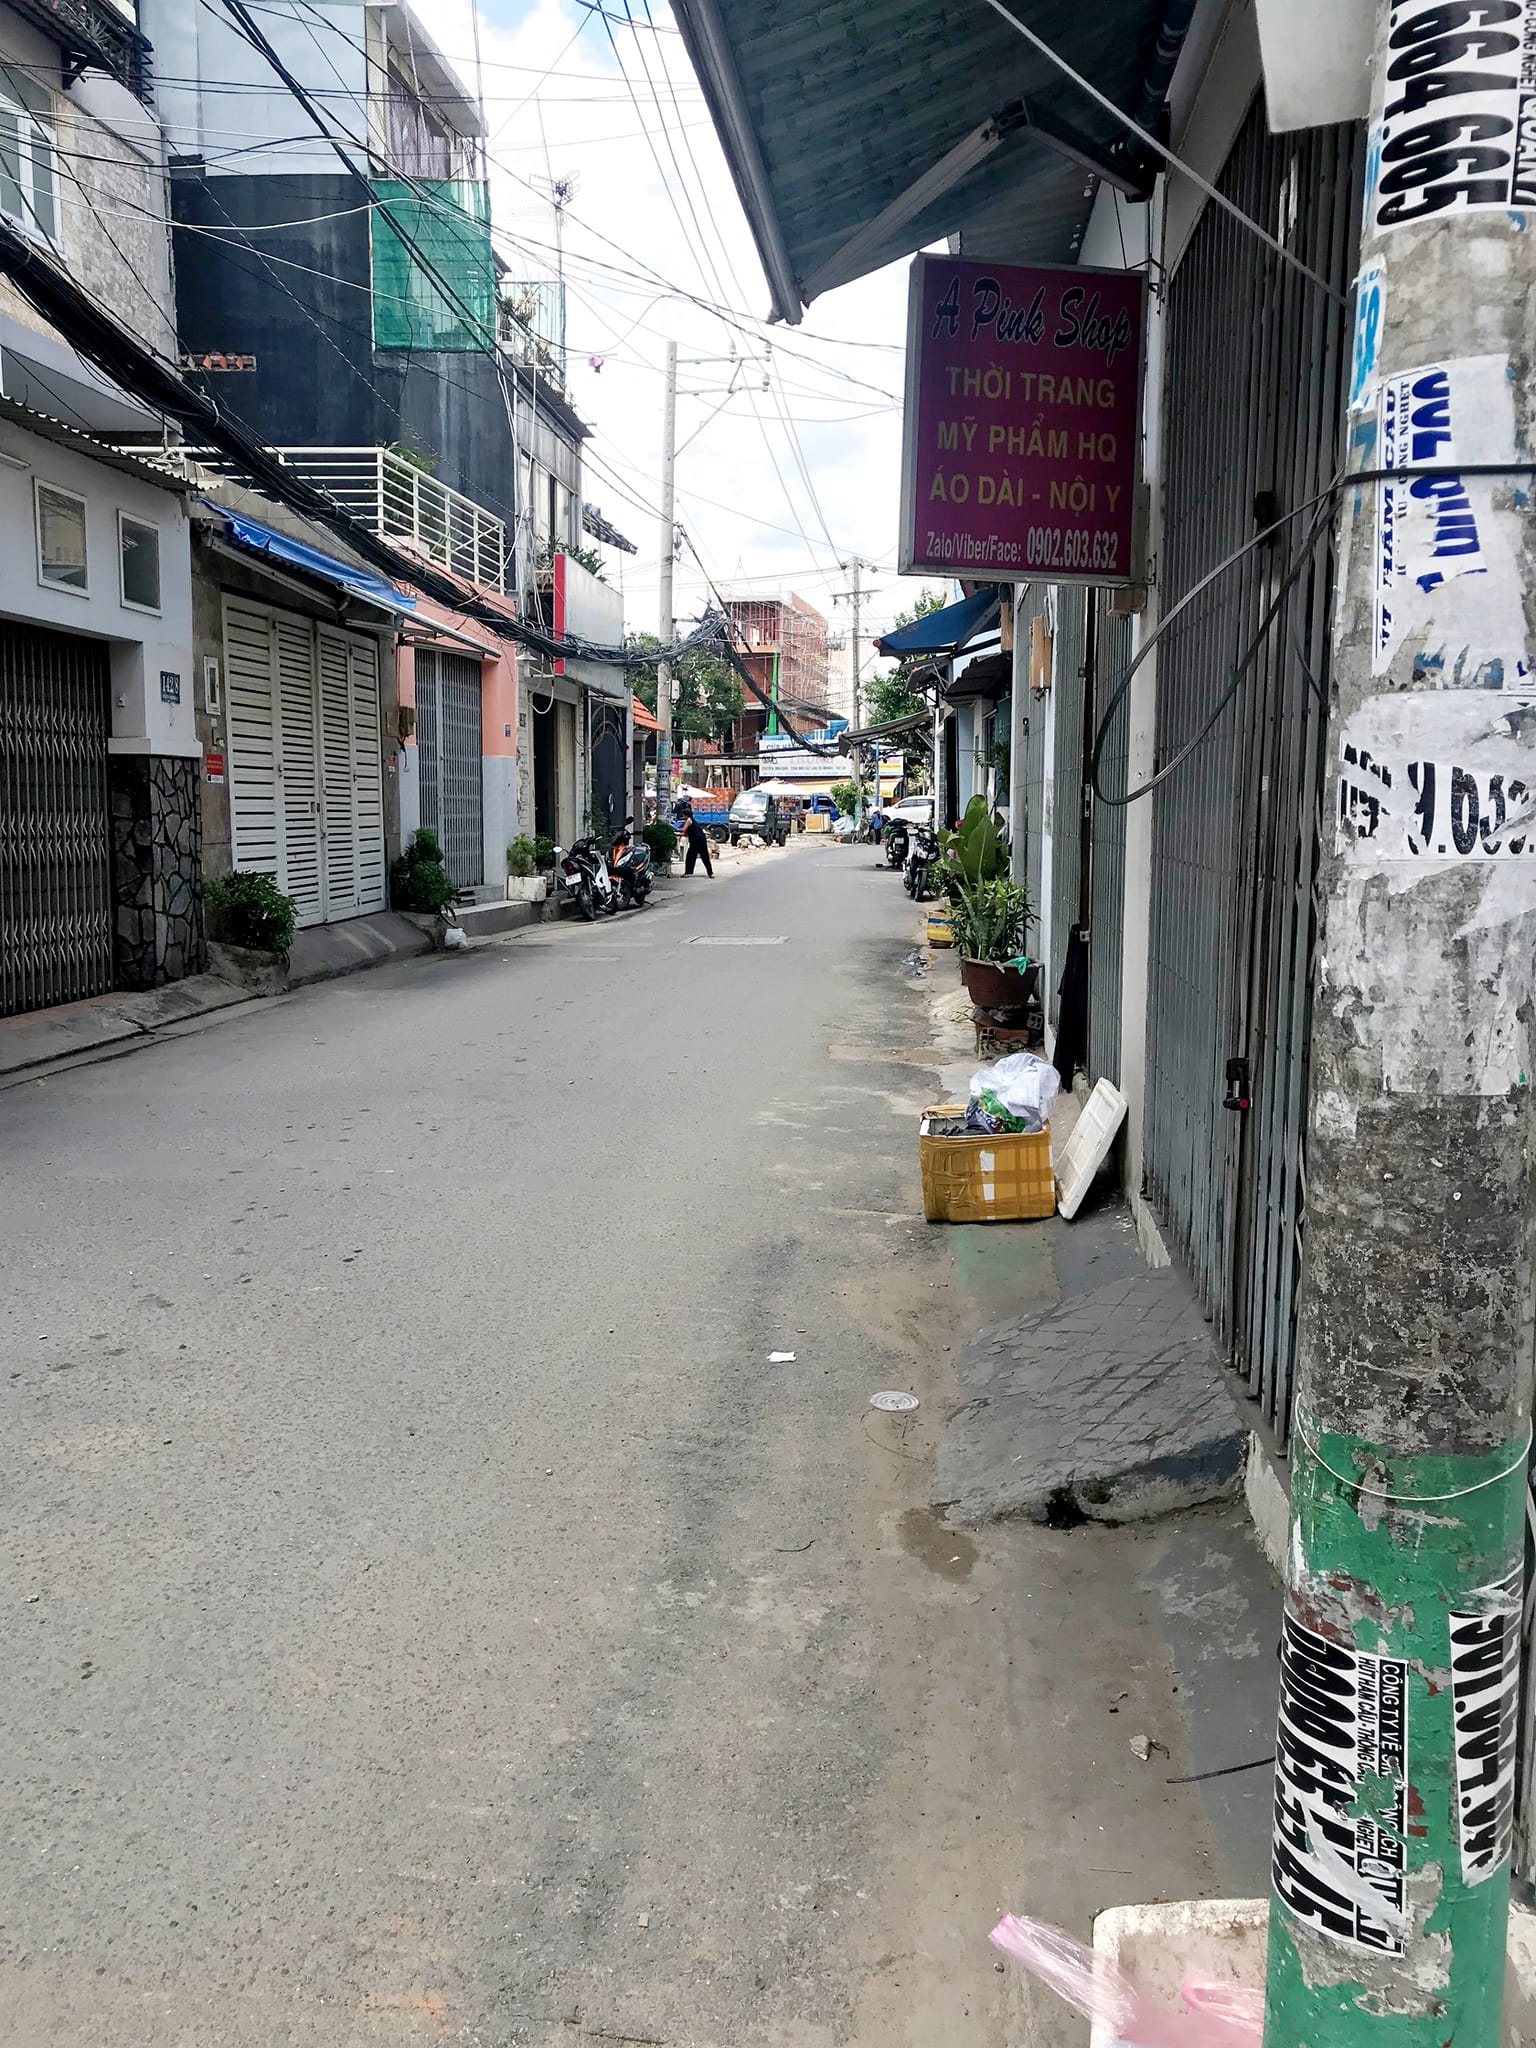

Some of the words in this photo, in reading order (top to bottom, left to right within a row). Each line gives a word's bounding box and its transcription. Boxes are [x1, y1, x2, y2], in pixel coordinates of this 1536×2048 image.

[1377, 0, 1522, 226] .664.665
[931, 276, 961, 340] A
[970, 276, 1047, 346] Pink
[1054, 287, 1131, 367] Shop
[945, 361, 1012, 400] THỜI
[1019, 372, 1116, 409] TRANG
[936, 416, 979, 452] MỸ
[988, 412, 1069, 459] PHẨM
[1078, 432, 1117, 463] HQ
[1382, 387, 1395, 469] CẦU
[928, 465, 970, 504] ÁO
[977, 469, 1023, 507] DÀI
[1049, 477, 1097, 517] NỘI
[1105, 484, 1121, 513] Y
[1026, 526, 1119, 569] 0902.603.632
[1359, 1656, 1378, 1679] HÚT
[1382, 1664, 1403, 1706] CÔNG
[1381, 1709, 1399, 1728] TY
[1379, 1732, 1402, 1752] VỆ
[1360, 1932, 1395, 1951] 7
